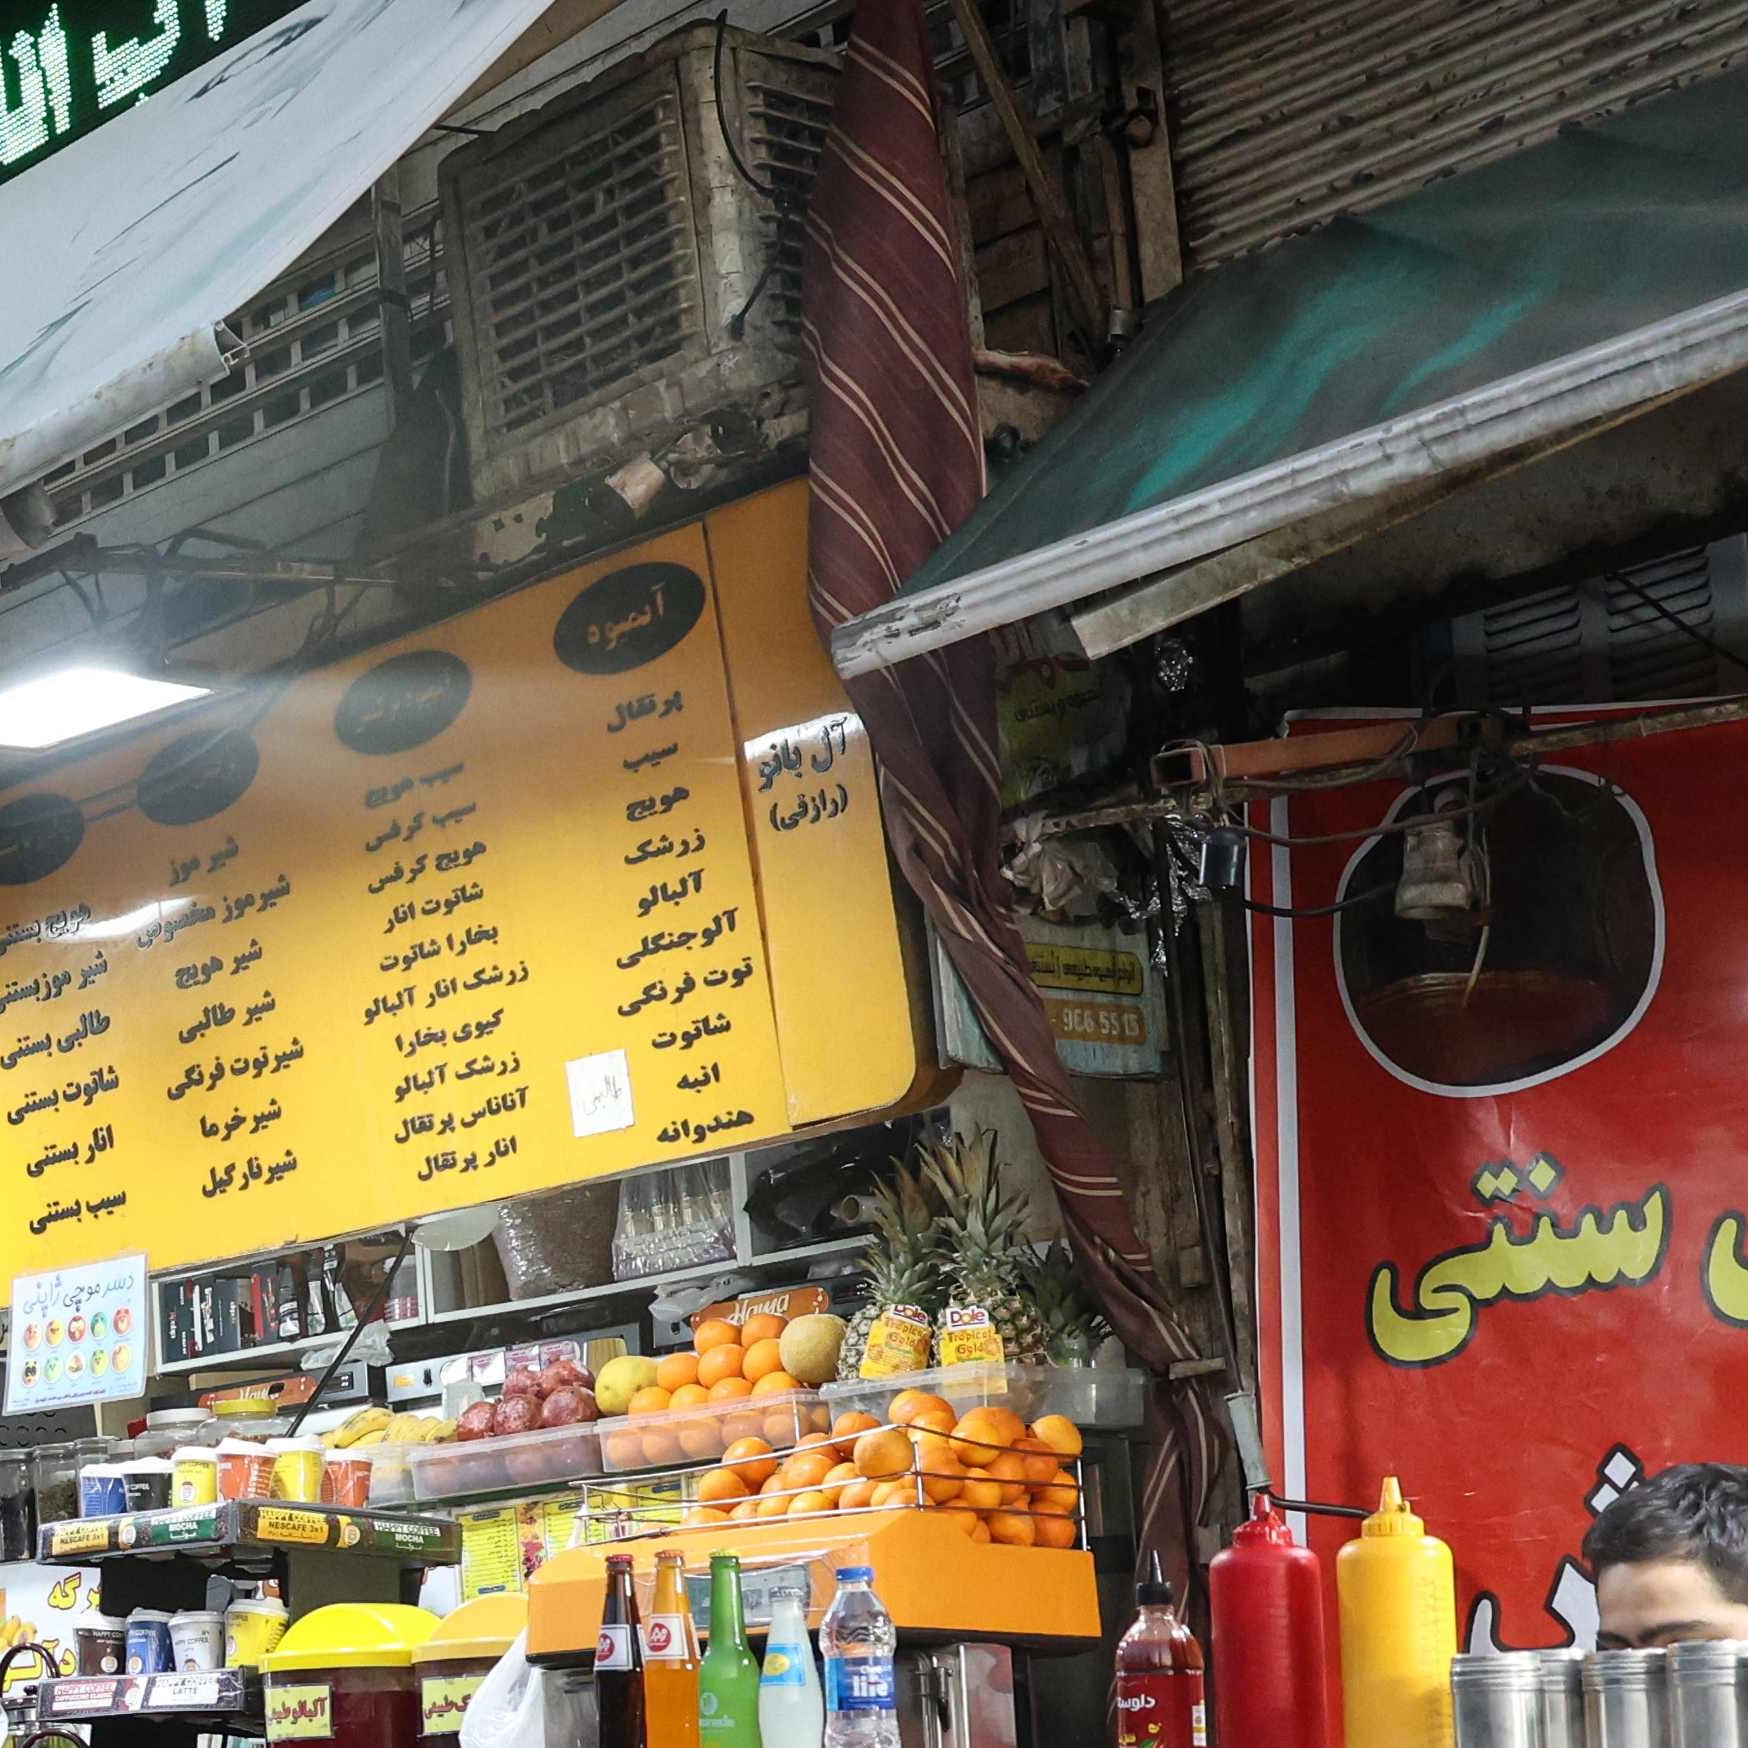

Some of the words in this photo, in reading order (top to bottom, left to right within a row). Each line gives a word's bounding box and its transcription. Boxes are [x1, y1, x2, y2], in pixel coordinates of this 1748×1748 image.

[623, 743, 679, 774] سیب
[626, 786, 690, 822] هویج
[435, 841, 487, 872] هویج
[624, 827, 706, 866] زرشک
[368, 854, 428, 894] کرفس
[421, 881, 484, 917] شاتوت
[637, 869, 704, 918] آلبالو
[383, 902, 416, 933] انار
[231, 938, 263, 976] شیر
[379, 938, 441, 973] شاتوت
[447, 924, 499, 956] بخارا
[175, 955, 224, 990] هویج
[462, 960, 529, 991] زرشک
[703, 957, 754, 988] توت
[242, 990, 276, 1025] شیر
[363, 986, 416, 1026] آلبالو
[425, 977, 457, 1008] انار
[618, 973, 696, 1018] فرنگی
[57, 1009, 110, 1052] طالبی
[179, 1001, 236, 1044] طالبی
[452, 1008, 504, 1043] کیوی
[651, 1013, 731, 1050] شاتوت
[0, 1033, 51, 1069] بستنی
[395, 1026, 447, 1058] بخارا
[394, 1063, 448, 1103] آلبالو
[455, 1051, 521, 1082] زرشک
[677, 1063, 721, 1094] انبه
[63, 1066, 119, 1104] شاتوت
[7, 1089, 59, 1125] بستنی
[200, 1107, 246, 1141] خرما
[249, 1098, 282, 1134] شیر
[460, 1086, 529, 1128] آناناس
[657, 1107, 755, 1142] هندوانه
[85, 1124, 114, 1163] انار
[394, 1111, 455, 1145] پرتقال
[27, 1142, 79, 1177] بستنی
[417, 1150, 478, 1182] پرتقال
[483, 1135, 518, 1168] انار
[30, 1199, 81, 1234] بستنی
[86, 1190, 127, 1219] سیب
[1367, 1155, 1670, 1364] سنتی
[950, 1308, 986, 1325] Dole
[853, 1671, 889, 1698] life
